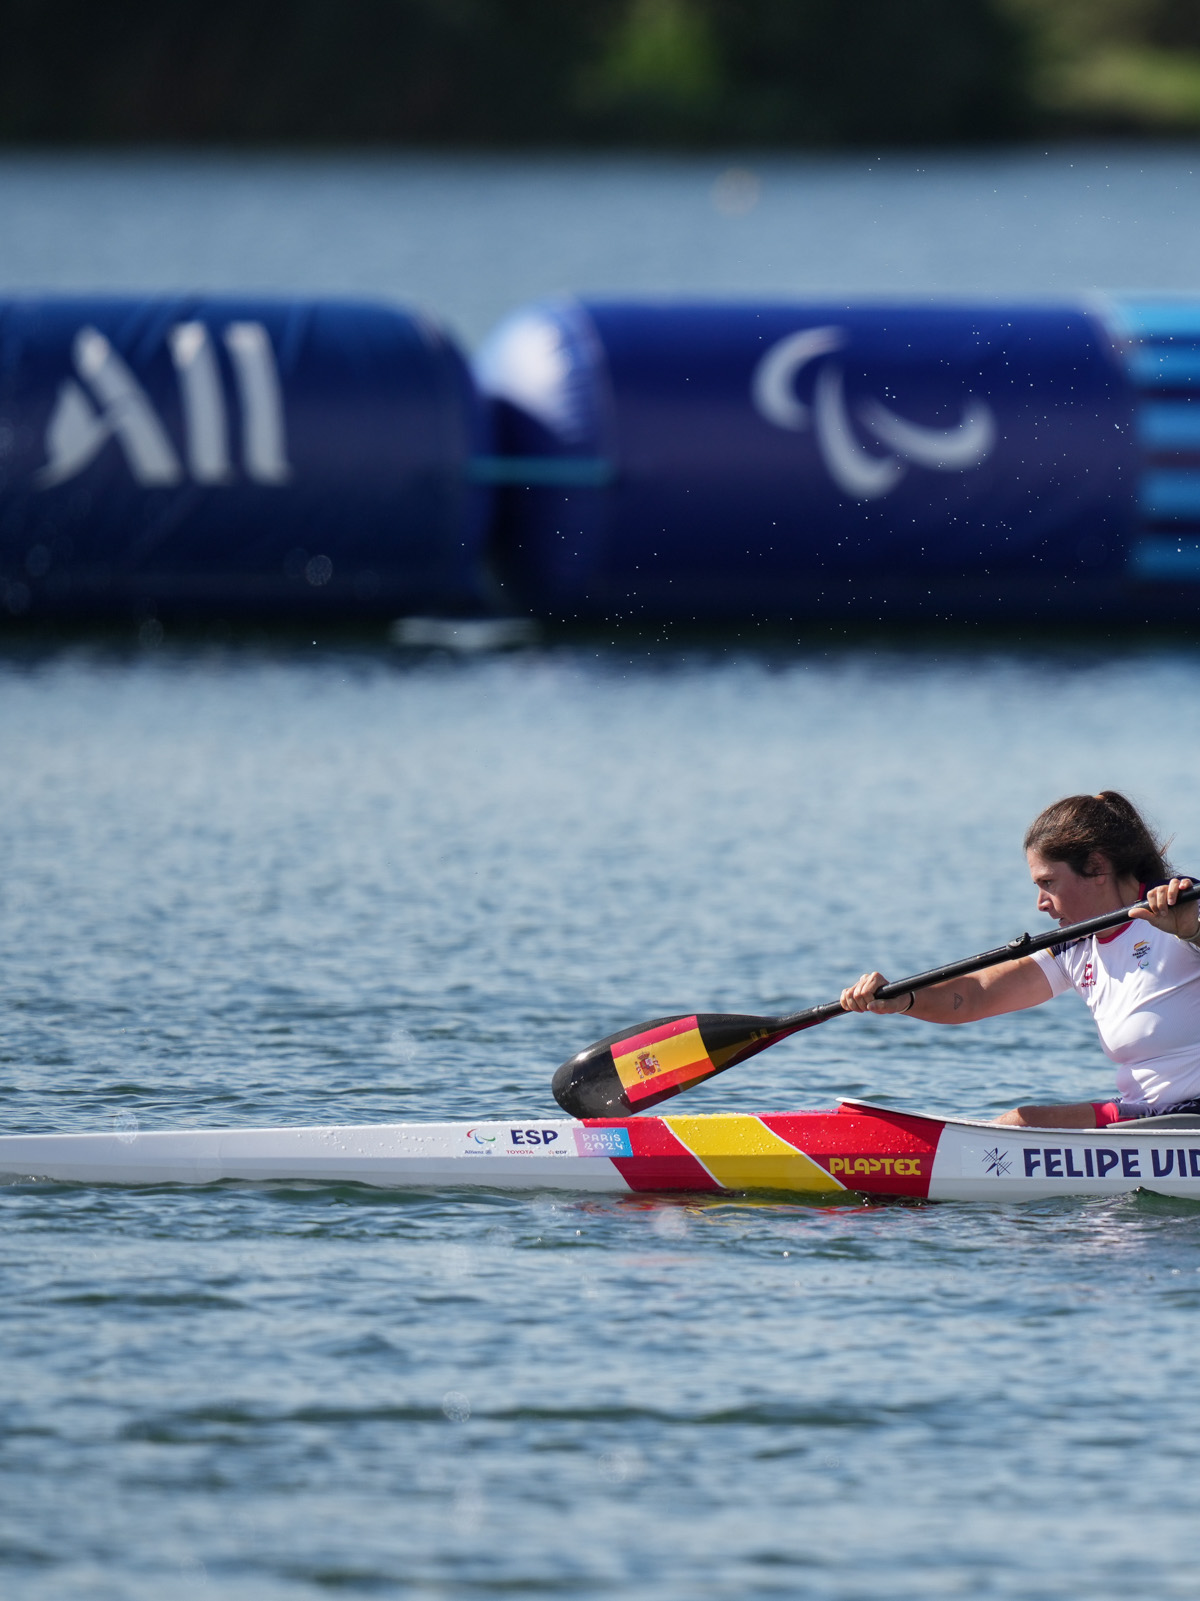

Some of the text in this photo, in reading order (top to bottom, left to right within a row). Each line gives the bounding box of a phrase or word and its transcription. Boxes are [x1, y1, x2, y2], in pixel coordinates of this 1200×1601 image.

[510, 1129, 558, 1145] ESP
[582, 1132, 621, 1142] PARIS
[584, 1142, 624, 1151] 2024
[829, 1158, 921, 1175] PLASTEX
[1023, 1148, 1141, 1177] FELIPE
